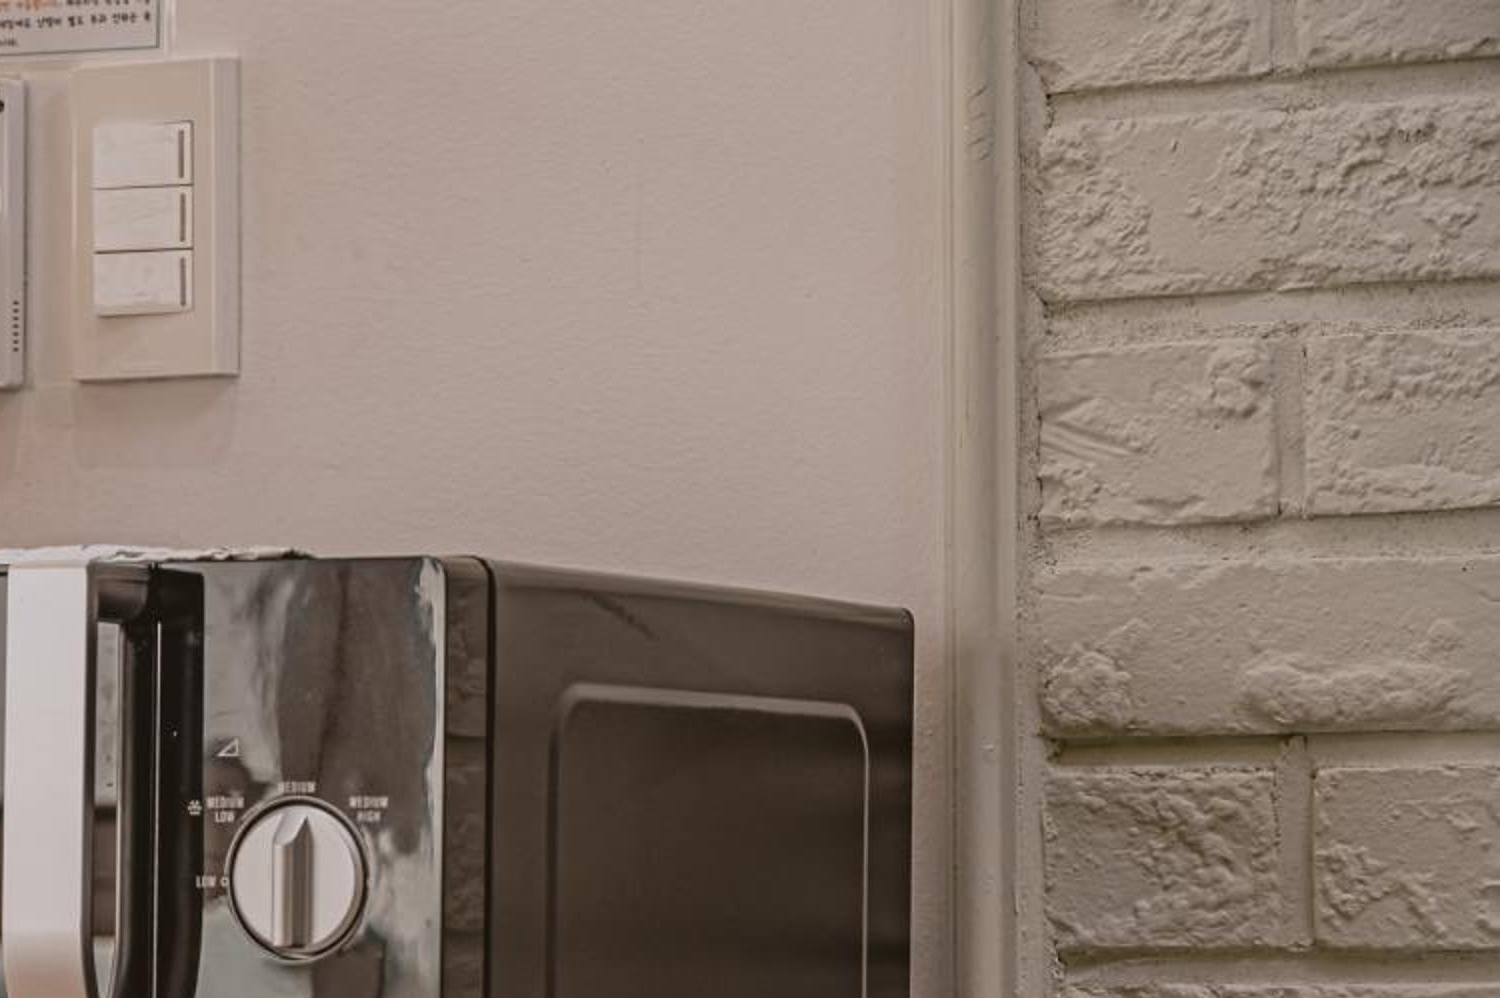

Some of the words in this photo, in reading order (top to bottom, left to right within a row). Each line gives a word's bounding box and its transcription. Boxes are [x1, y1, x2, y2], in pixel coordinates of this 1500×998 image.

[277, 781, 316, 793] MEDIUM
[206, 796, 244, 808] MEDIUM
[349, 796, 389, 808] MEDIUM
[215, 811, 235, 823] LOW
[196, 876, 216, 888] LOW
